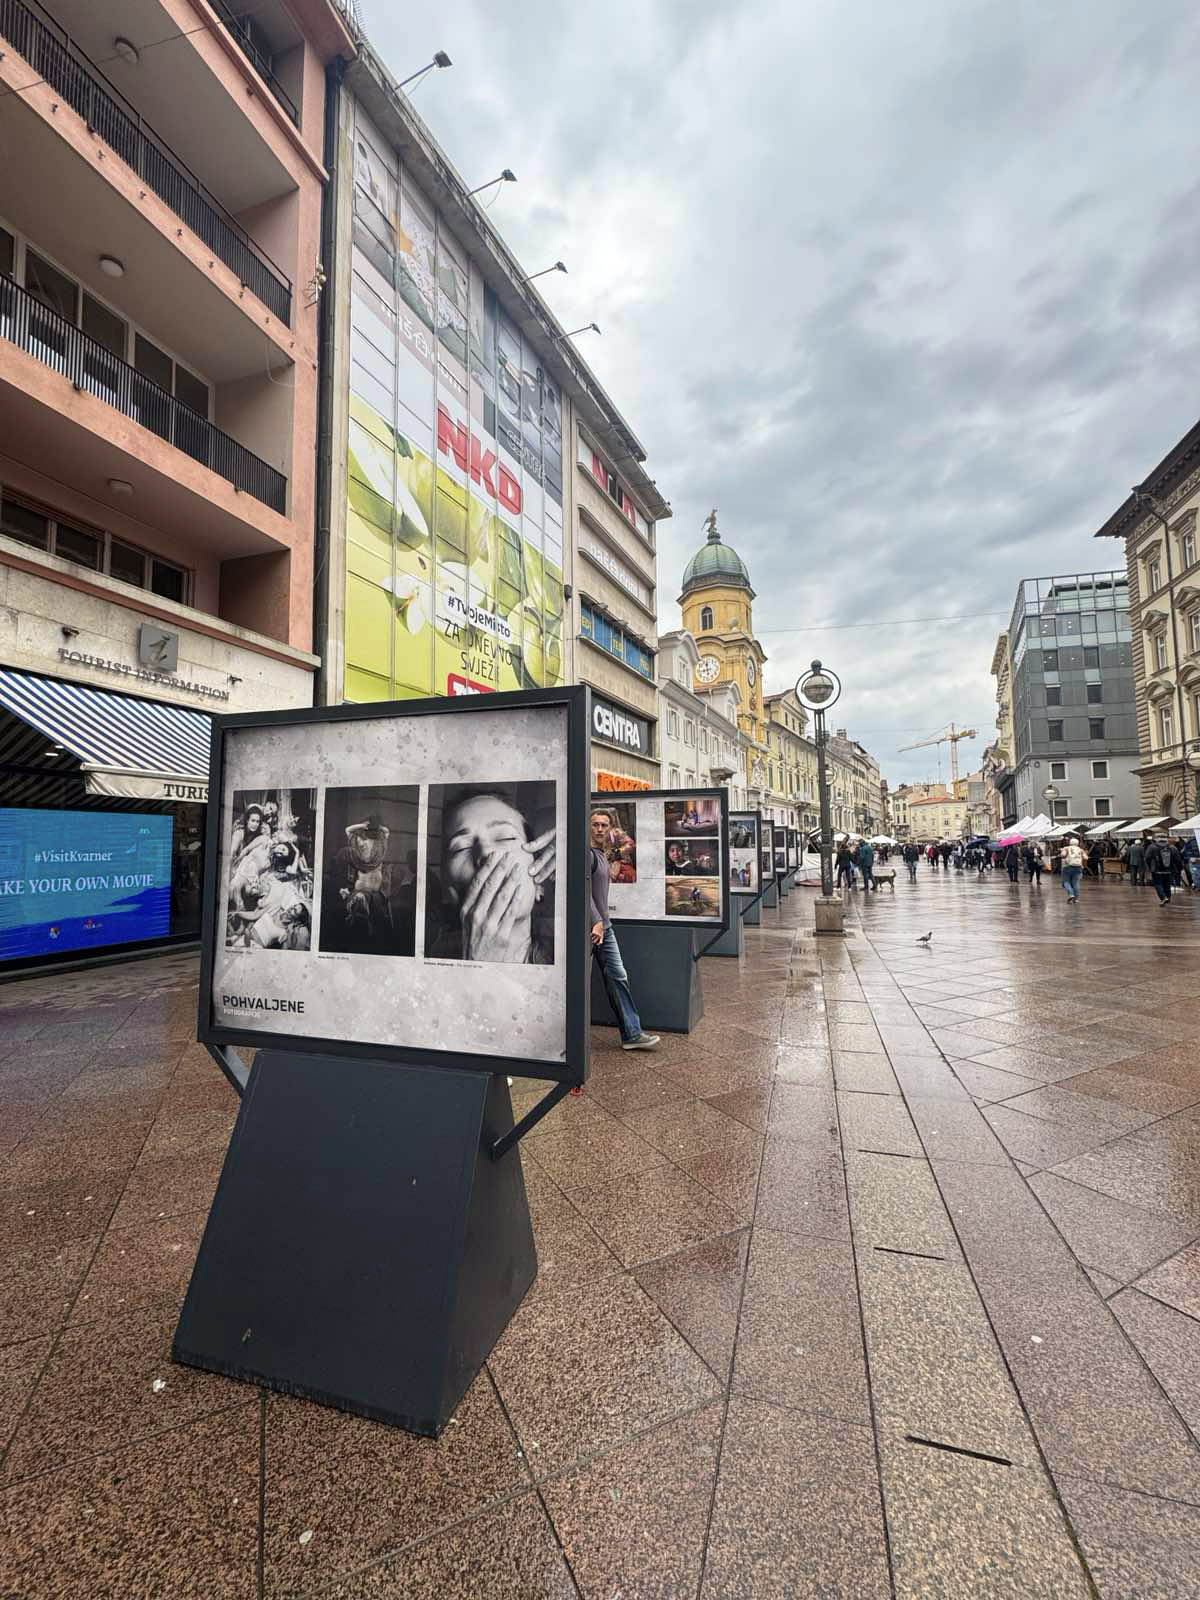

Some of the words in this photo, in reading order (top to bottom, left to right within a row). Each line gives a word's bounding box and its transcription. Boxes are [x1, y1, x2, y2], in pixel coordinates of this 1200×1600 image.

[438, 400, 521, 516] NKD
[444, 618, 461, 642] ZA
[58, 647, 132, 674] TOURIST
[136, 668, 231, 701] INFORMATION
[593, 704, 641, 749] CENTRA
[34, 848, 113, 864] #VisitKvarner
[29, 878, 73, 894] YOUR
[75, 876, 110, 891] OWN
[112, 874, 154, 889] MOVIE
[222, 994, 305, 1014] POHVALJENE
